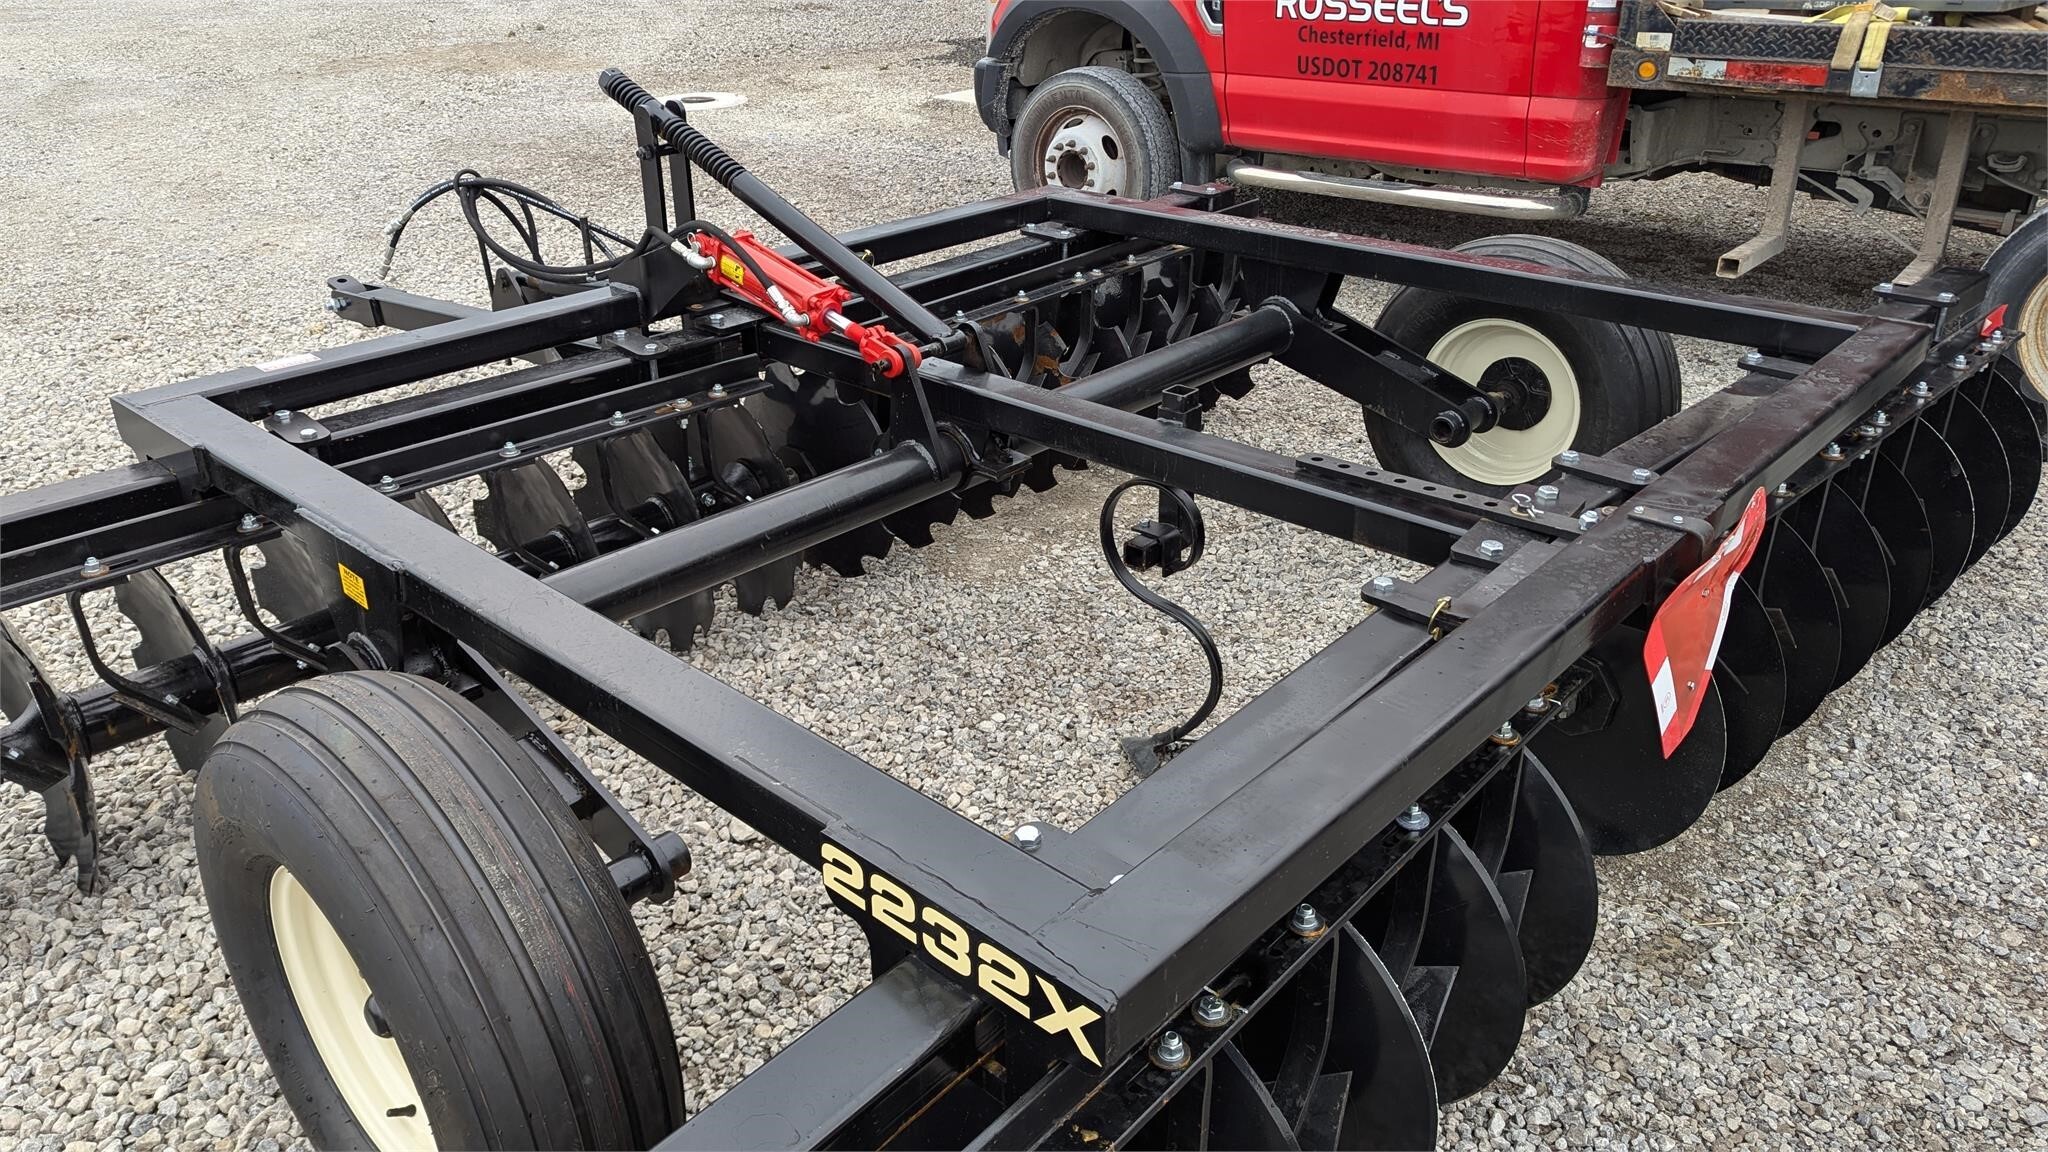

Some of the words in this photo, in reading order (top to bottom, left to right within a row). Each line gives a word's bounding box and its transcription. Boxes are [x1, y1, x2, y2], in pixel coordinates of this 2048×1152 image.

[1297, 25, 1410, 51] Chesterfield,
[1416, 32, 1440, 50] MI
[1297, 55, 1362, 79] USDOT
[1367, 61, 1438, 85] 208741
[821, 843, 1102, 1068] 2232X
